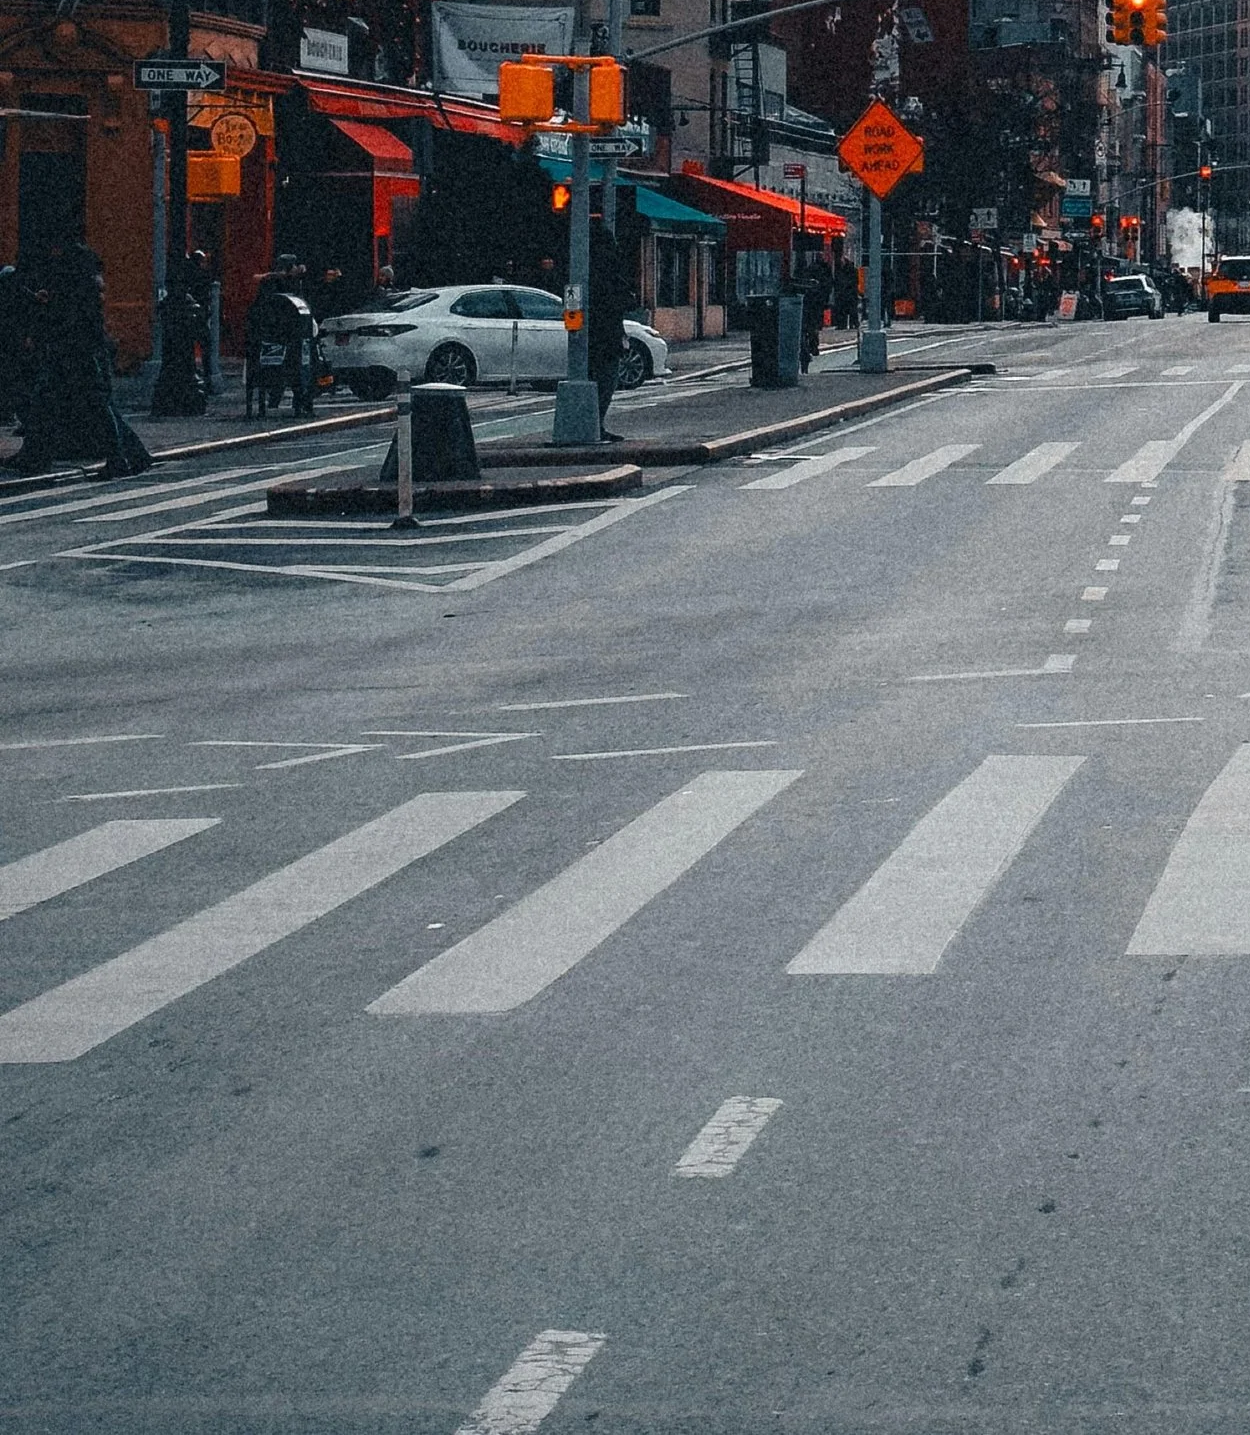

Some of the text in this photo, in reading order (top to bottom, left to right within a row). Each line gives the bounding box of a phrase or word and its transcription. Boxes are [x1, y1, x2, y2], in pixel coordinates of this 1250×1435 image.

[457, 39, 546, 54] BOUCHERIE
[147, 70, 213, 82] ONE WAY
[864, 126, 896, 138] ROAD
[591, 144, 632, 152] ONE WAY
[864, 144, 895, 155] WORK
[861, 160, 900, 173] AHEAD
